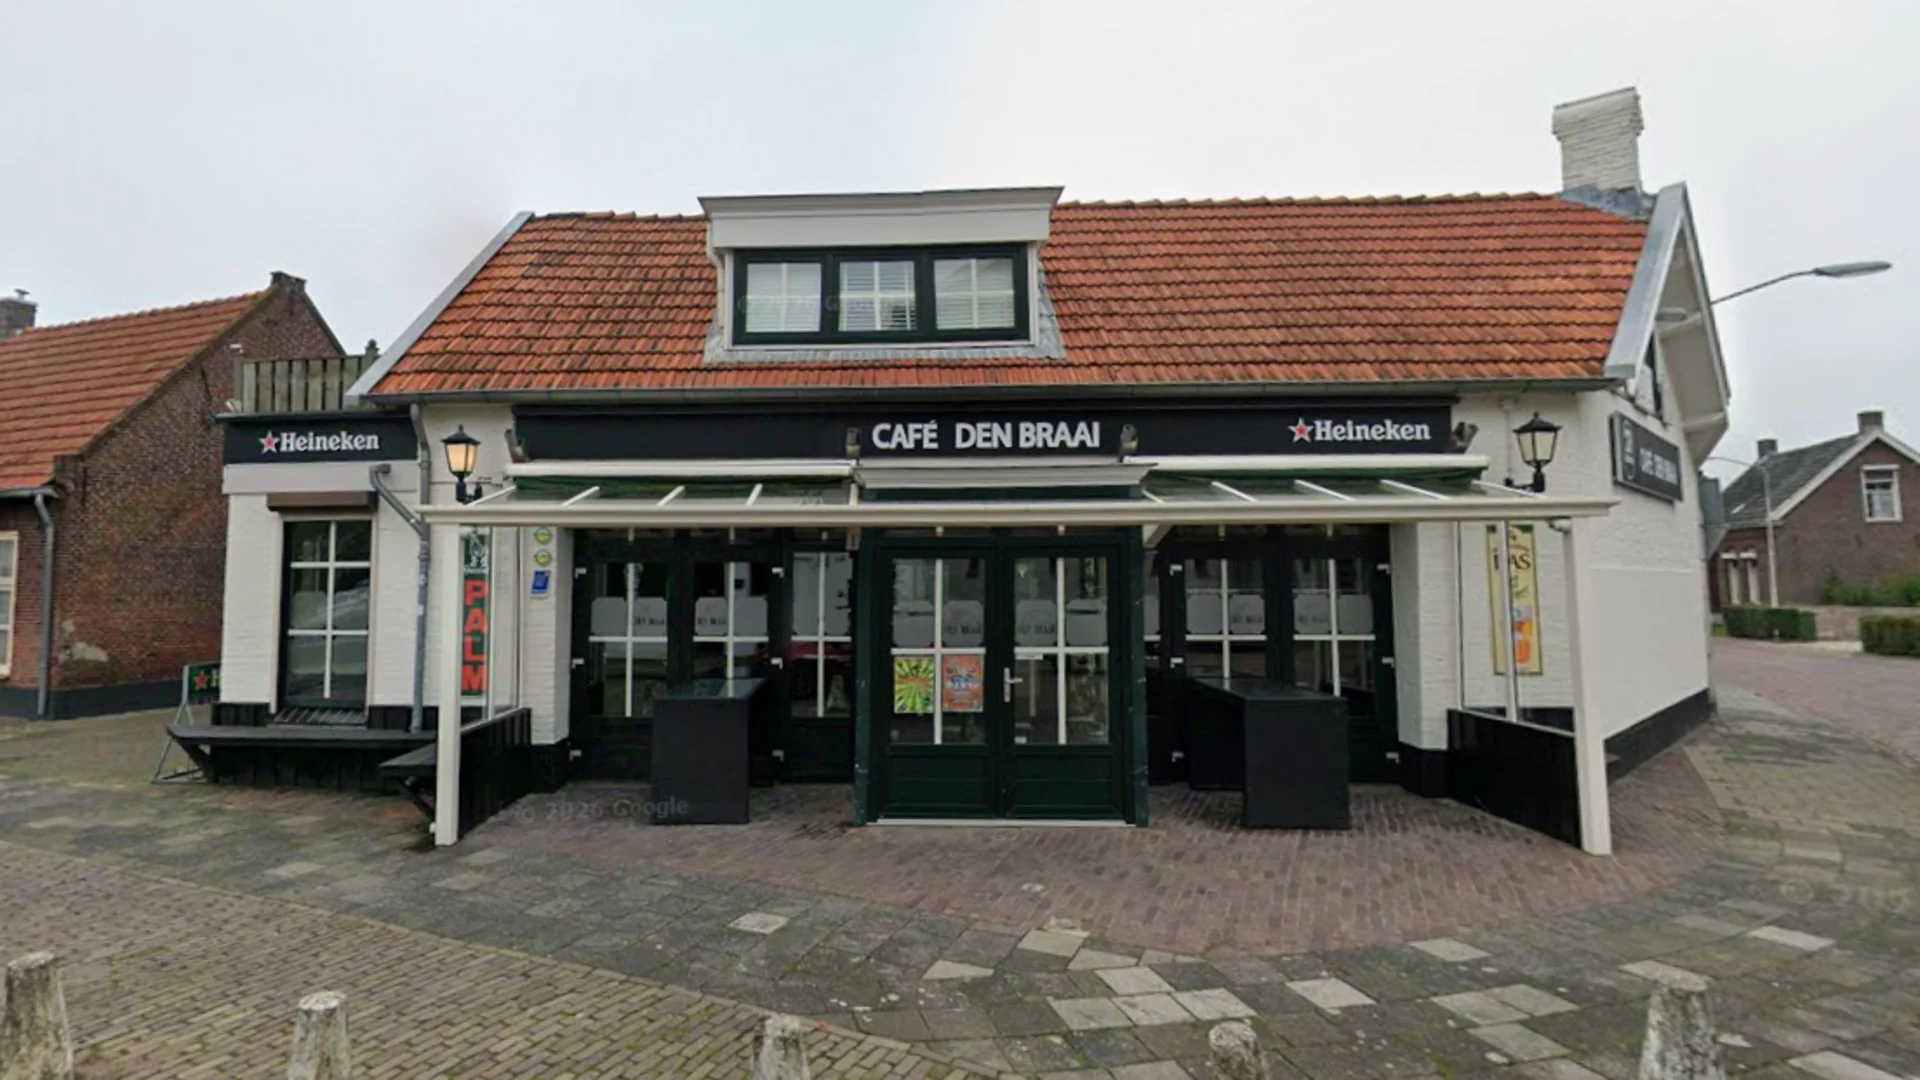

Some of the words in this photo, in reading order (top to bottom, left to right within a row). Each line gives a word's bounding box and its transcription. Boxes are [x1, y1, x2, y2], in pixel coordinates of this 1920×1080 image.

[279, 430, 380, 453] Heineken
[871, 420, 939, 450] CAFÉ
[955, 422, 1012, 449] DEN
[1018, 421, 1100, 448] BRAAI
[1313, 418, 1432, 442] Heineken
[461, 579, 489, 692] PALM
